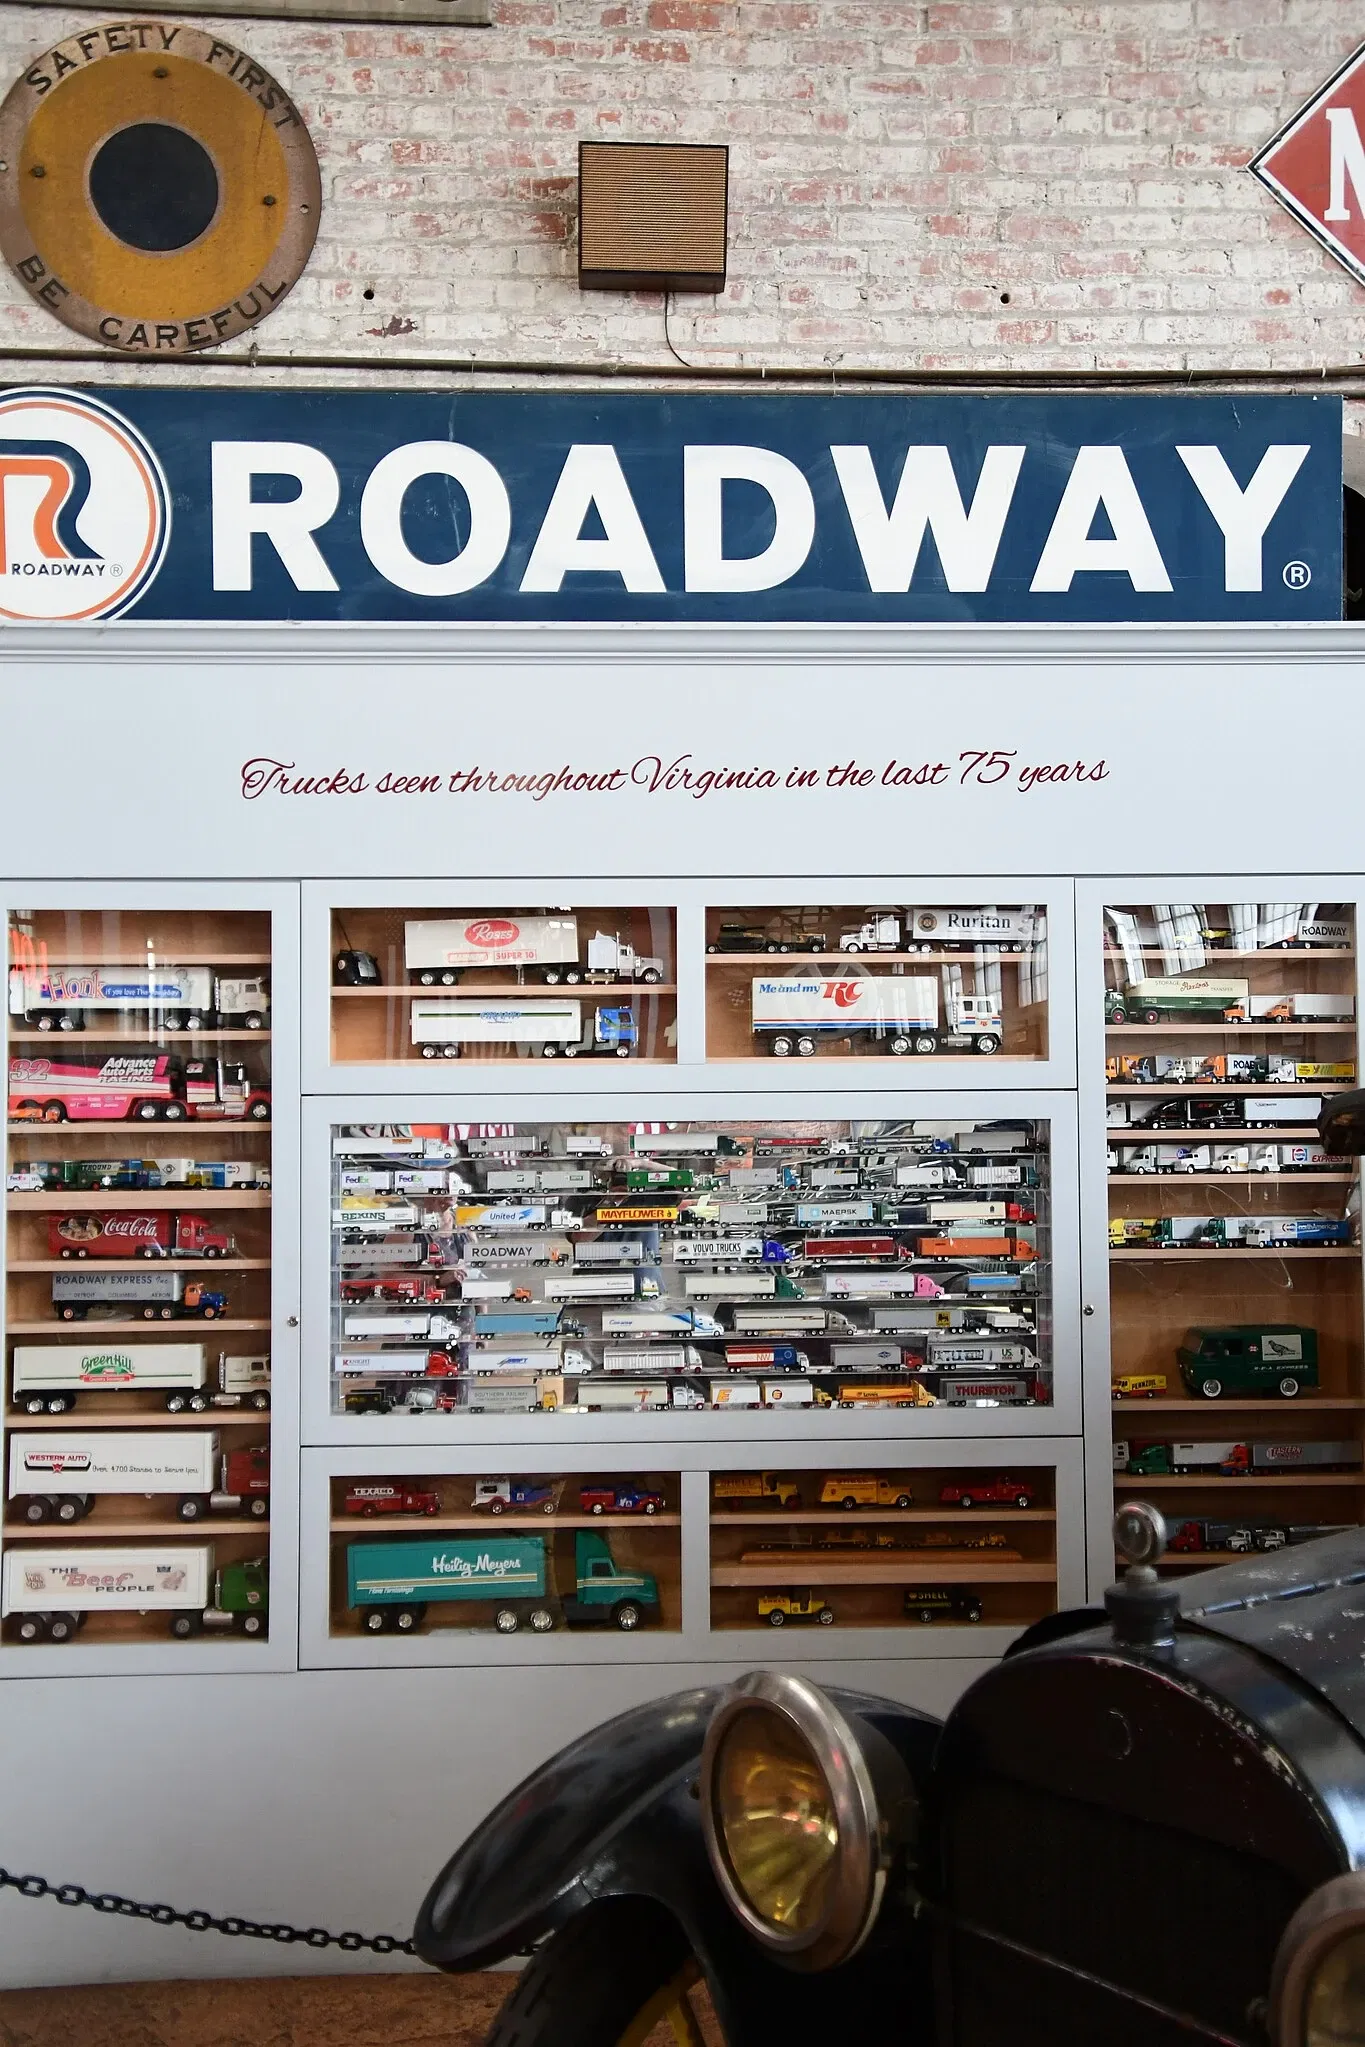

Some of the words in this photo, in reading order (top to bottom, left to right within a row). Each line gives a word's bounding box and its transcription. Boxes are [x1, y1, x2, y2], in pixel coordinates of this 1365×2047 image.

[26, 24, 182, 96] SAFETY
[206, 43, 302, 131] FIRST
[16, 253, 69, 309] BE
[99, 278, 287, 350] CAREFUL
[211, 440, 1311, 597] ROADWAY
[11, 562, 106, 578] ROADWAY
[241, 757, 370, 800] Trucks
[374, 771, 443, 794] seen
[448, 765, 629, 802] throughout
[631, 754, 781, 799] Virginia
[785, 765, 820, 788] in
[826, 759, 876, 788] the
[881, 759, 952, 786] last
[958, 749, 1018, 785] 75
[1017, 759, 1110, 793] years
[947, 913, 1011, 929] Ruritan
[473, 923, 513, 942] Roses
[1301, 926, 1348, 936] ROADWAY
[495, 951, 522, 960] SUPER
[525, 951, 535, 959] 10
[46, 970, 107, 1004] Honk
[123, 988, 136, 996] love
[759, 984, 777, 994] Me
[778, 983, 801, 993] and
[802, 985, 820, 995] my
[820, 981, 865, 1008] RC
[106, 1057, 156, 1069] Advance
[186, 1063, 205, 1074] 32
[10, 1058, 51, 1082] 32
[98, 1067, 125, 1076] Auto
[125, 1067, 154, 1076] Parts
[98, 1075, 154, 1083] RACING
[345, 1175, 370, 1184] FedEx
[398, 1174, 423, 1183] FedEx
[489, 1212, 516, 1221] United
[601, 1209, 665, 1219] MAYFLOWER
[821, 1208, 857, 1216] MAERSK
[104, 1217, 158, 1237] Coca-Cola
[471, 1247, 533, 1257] ROADWAY
[692, 1243, 714, 1253] VOLVO
[716, 1242, 741, 1252] TRUCKS
[55, 1275, 107, 1285] ROADWAY
[110, 1275, 152, 1284] EXPRESS
[955, 1384, 1016, 1396] THURSTON
[354, 1487, 395, 1496] TEXACO
[431, 1554, 521, 1578] Heilig-Meyers
[62, 1572, 134, 1587] Beef
[95, 1585, 155, 1593] PEOPLE
[918, 1592, 948, 1600] SHELL
